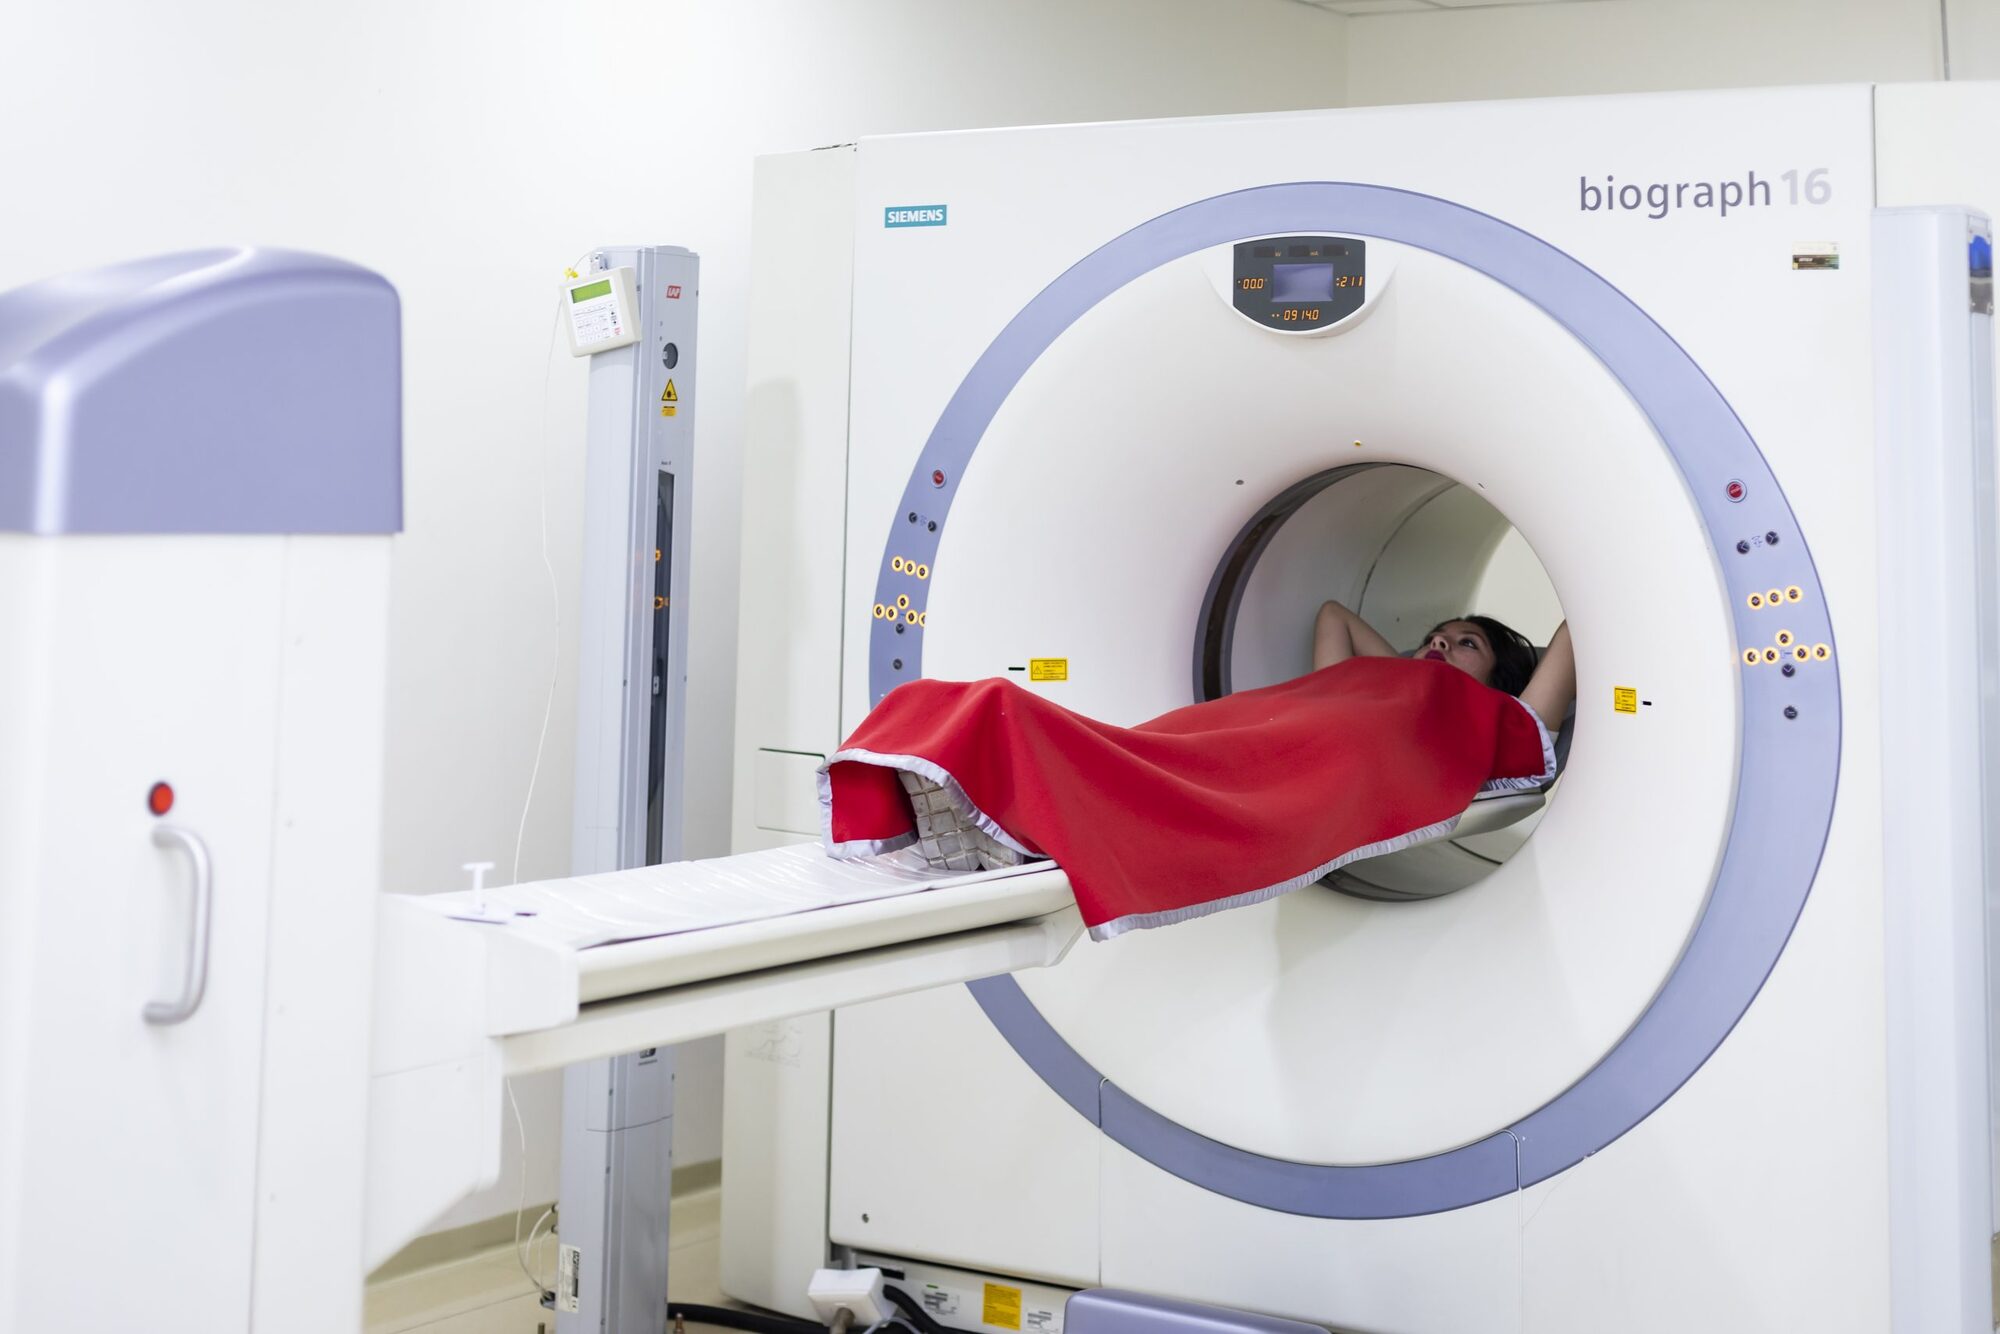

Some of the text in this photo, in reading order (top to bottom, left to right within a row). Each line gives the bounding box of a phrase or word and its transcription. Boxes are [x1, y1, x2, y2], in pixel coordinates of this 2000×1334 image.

[1580, 167, 1832, 220] biograph 16
[887, 208, 944, 224] SIEMENS
